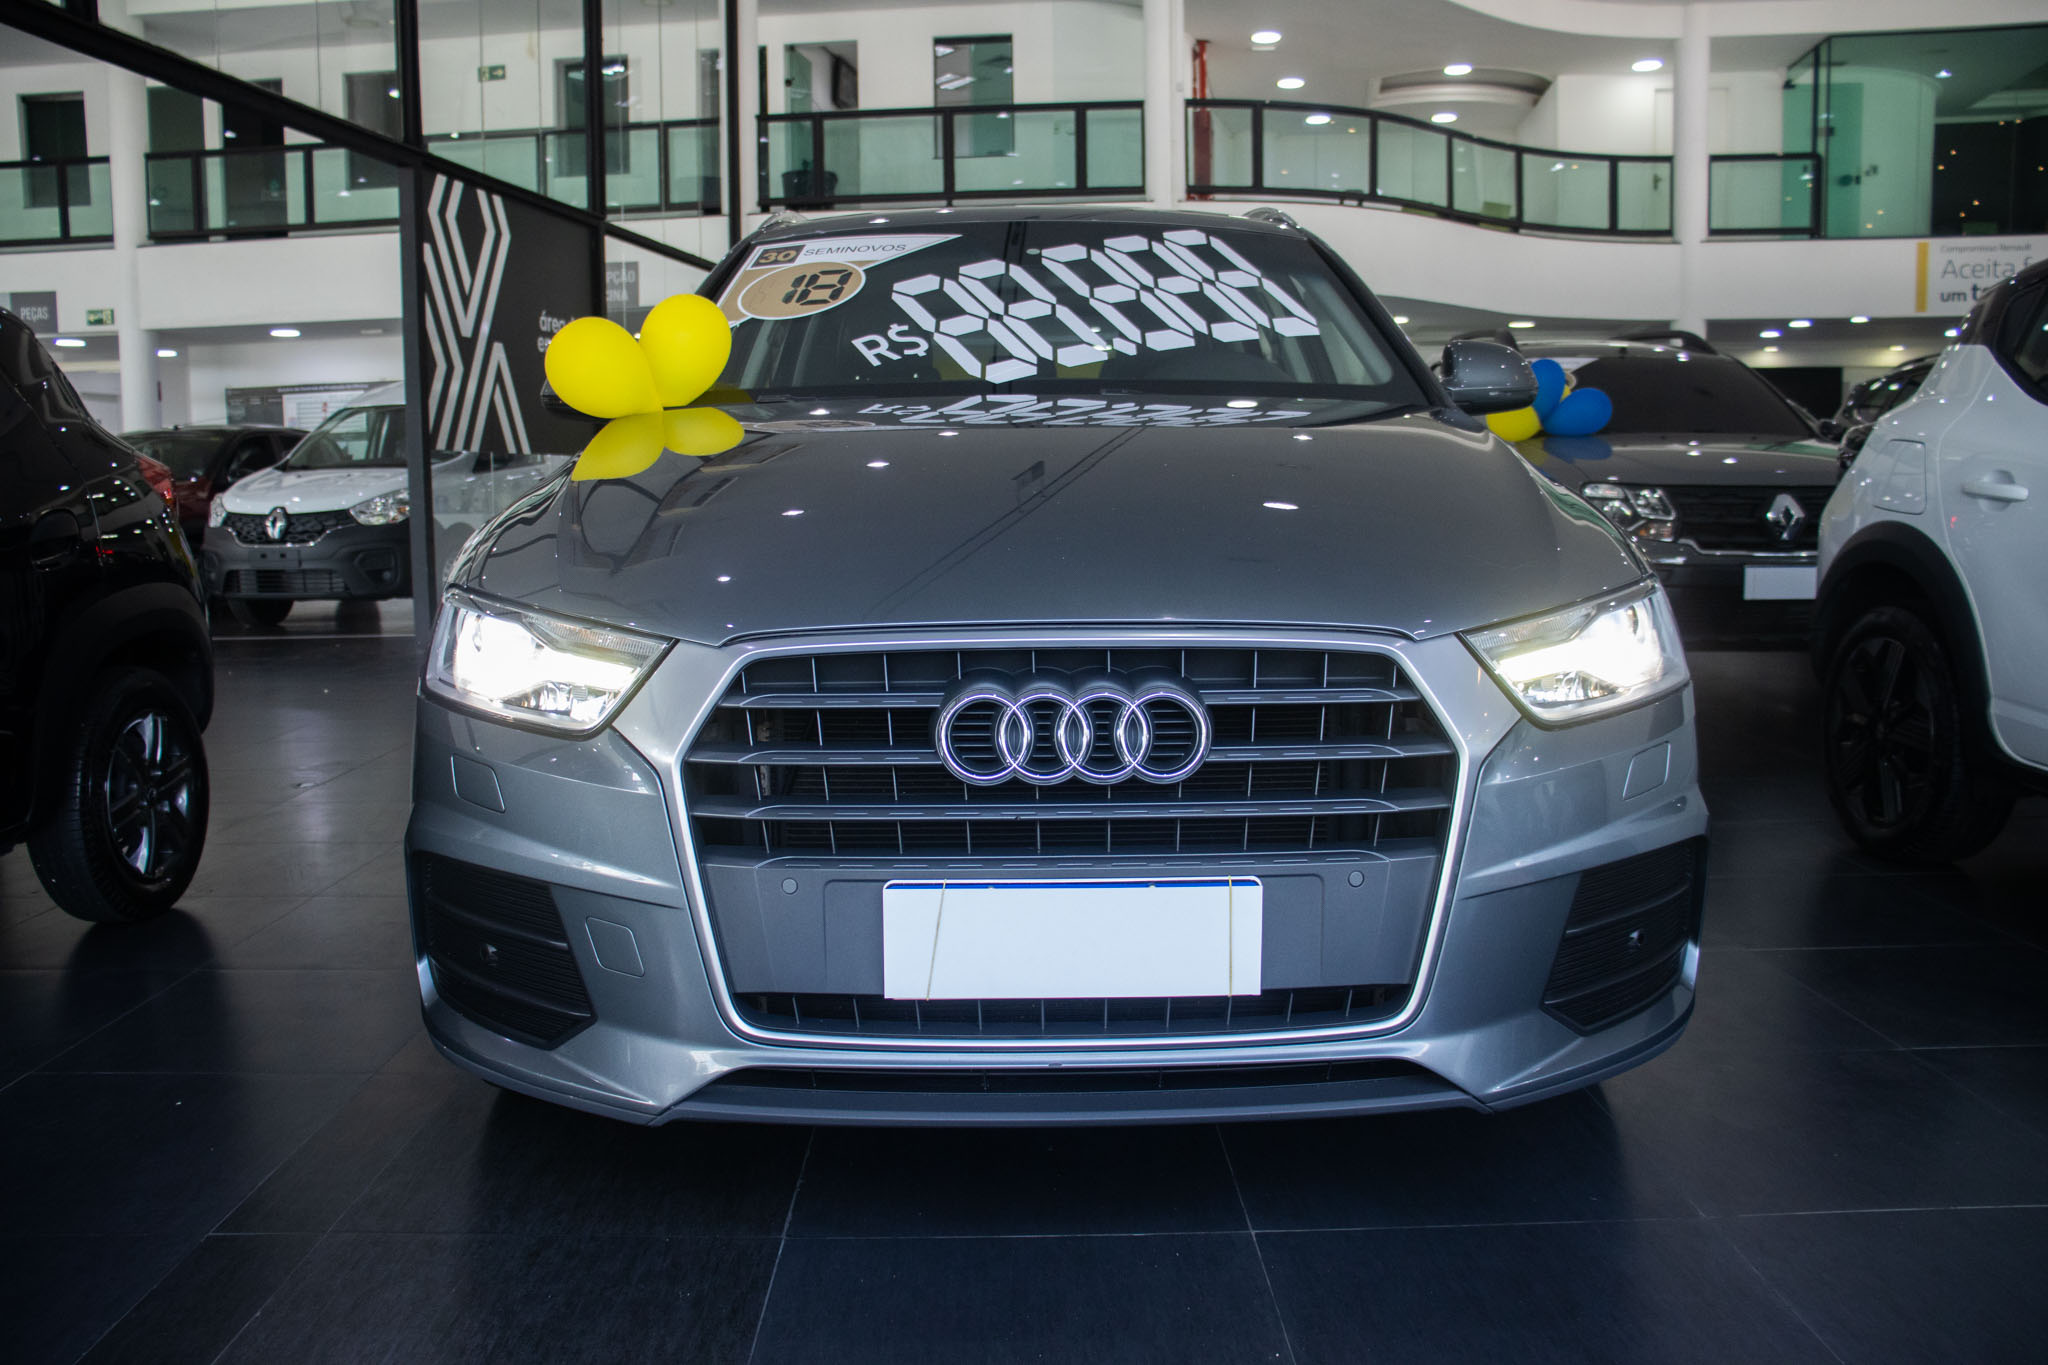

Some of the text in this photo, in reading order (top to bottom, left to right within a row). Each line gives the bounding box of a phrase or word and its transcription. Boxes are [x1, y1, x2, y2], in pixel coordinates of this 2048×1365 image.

[758, 244, 907, 264] 30 SEMINOVOS
[1941, 258, 2016, 279] Aceita
[1940, 290, 1967, 302] um
[20, 306, 48, 322] PEÇAS
[851, 324, 929, 367] R$
